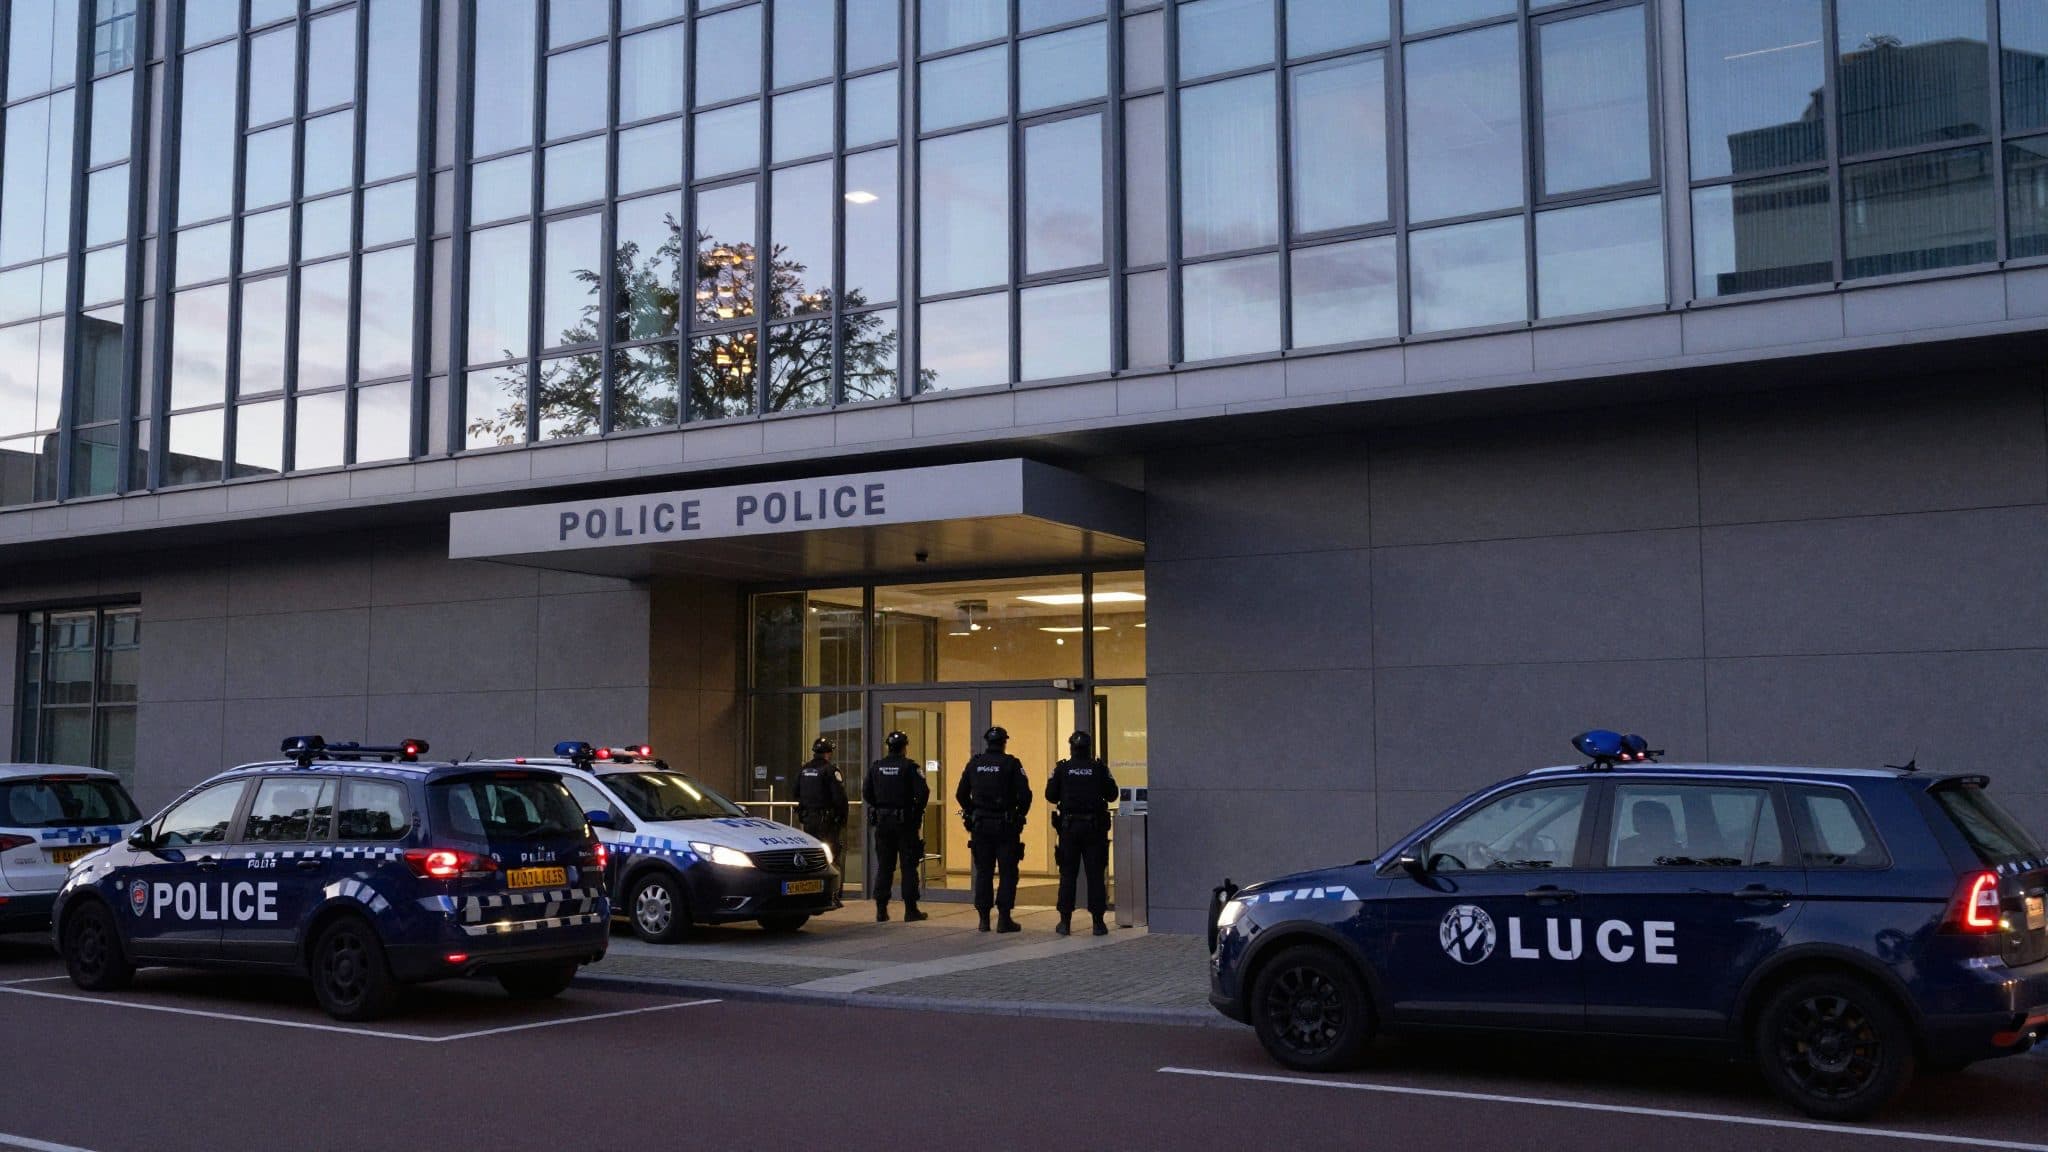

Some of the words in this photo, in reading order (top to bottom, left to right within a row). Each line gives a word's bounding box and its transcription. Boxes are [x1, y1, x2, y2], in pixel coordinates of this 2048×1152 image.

[559, 500, 701, 541] POLICE
[736, 483, 886, 527] POLICE
[153, 881, 278, 921] POLICE
[1508, 916, 1678, 964] LUCE
